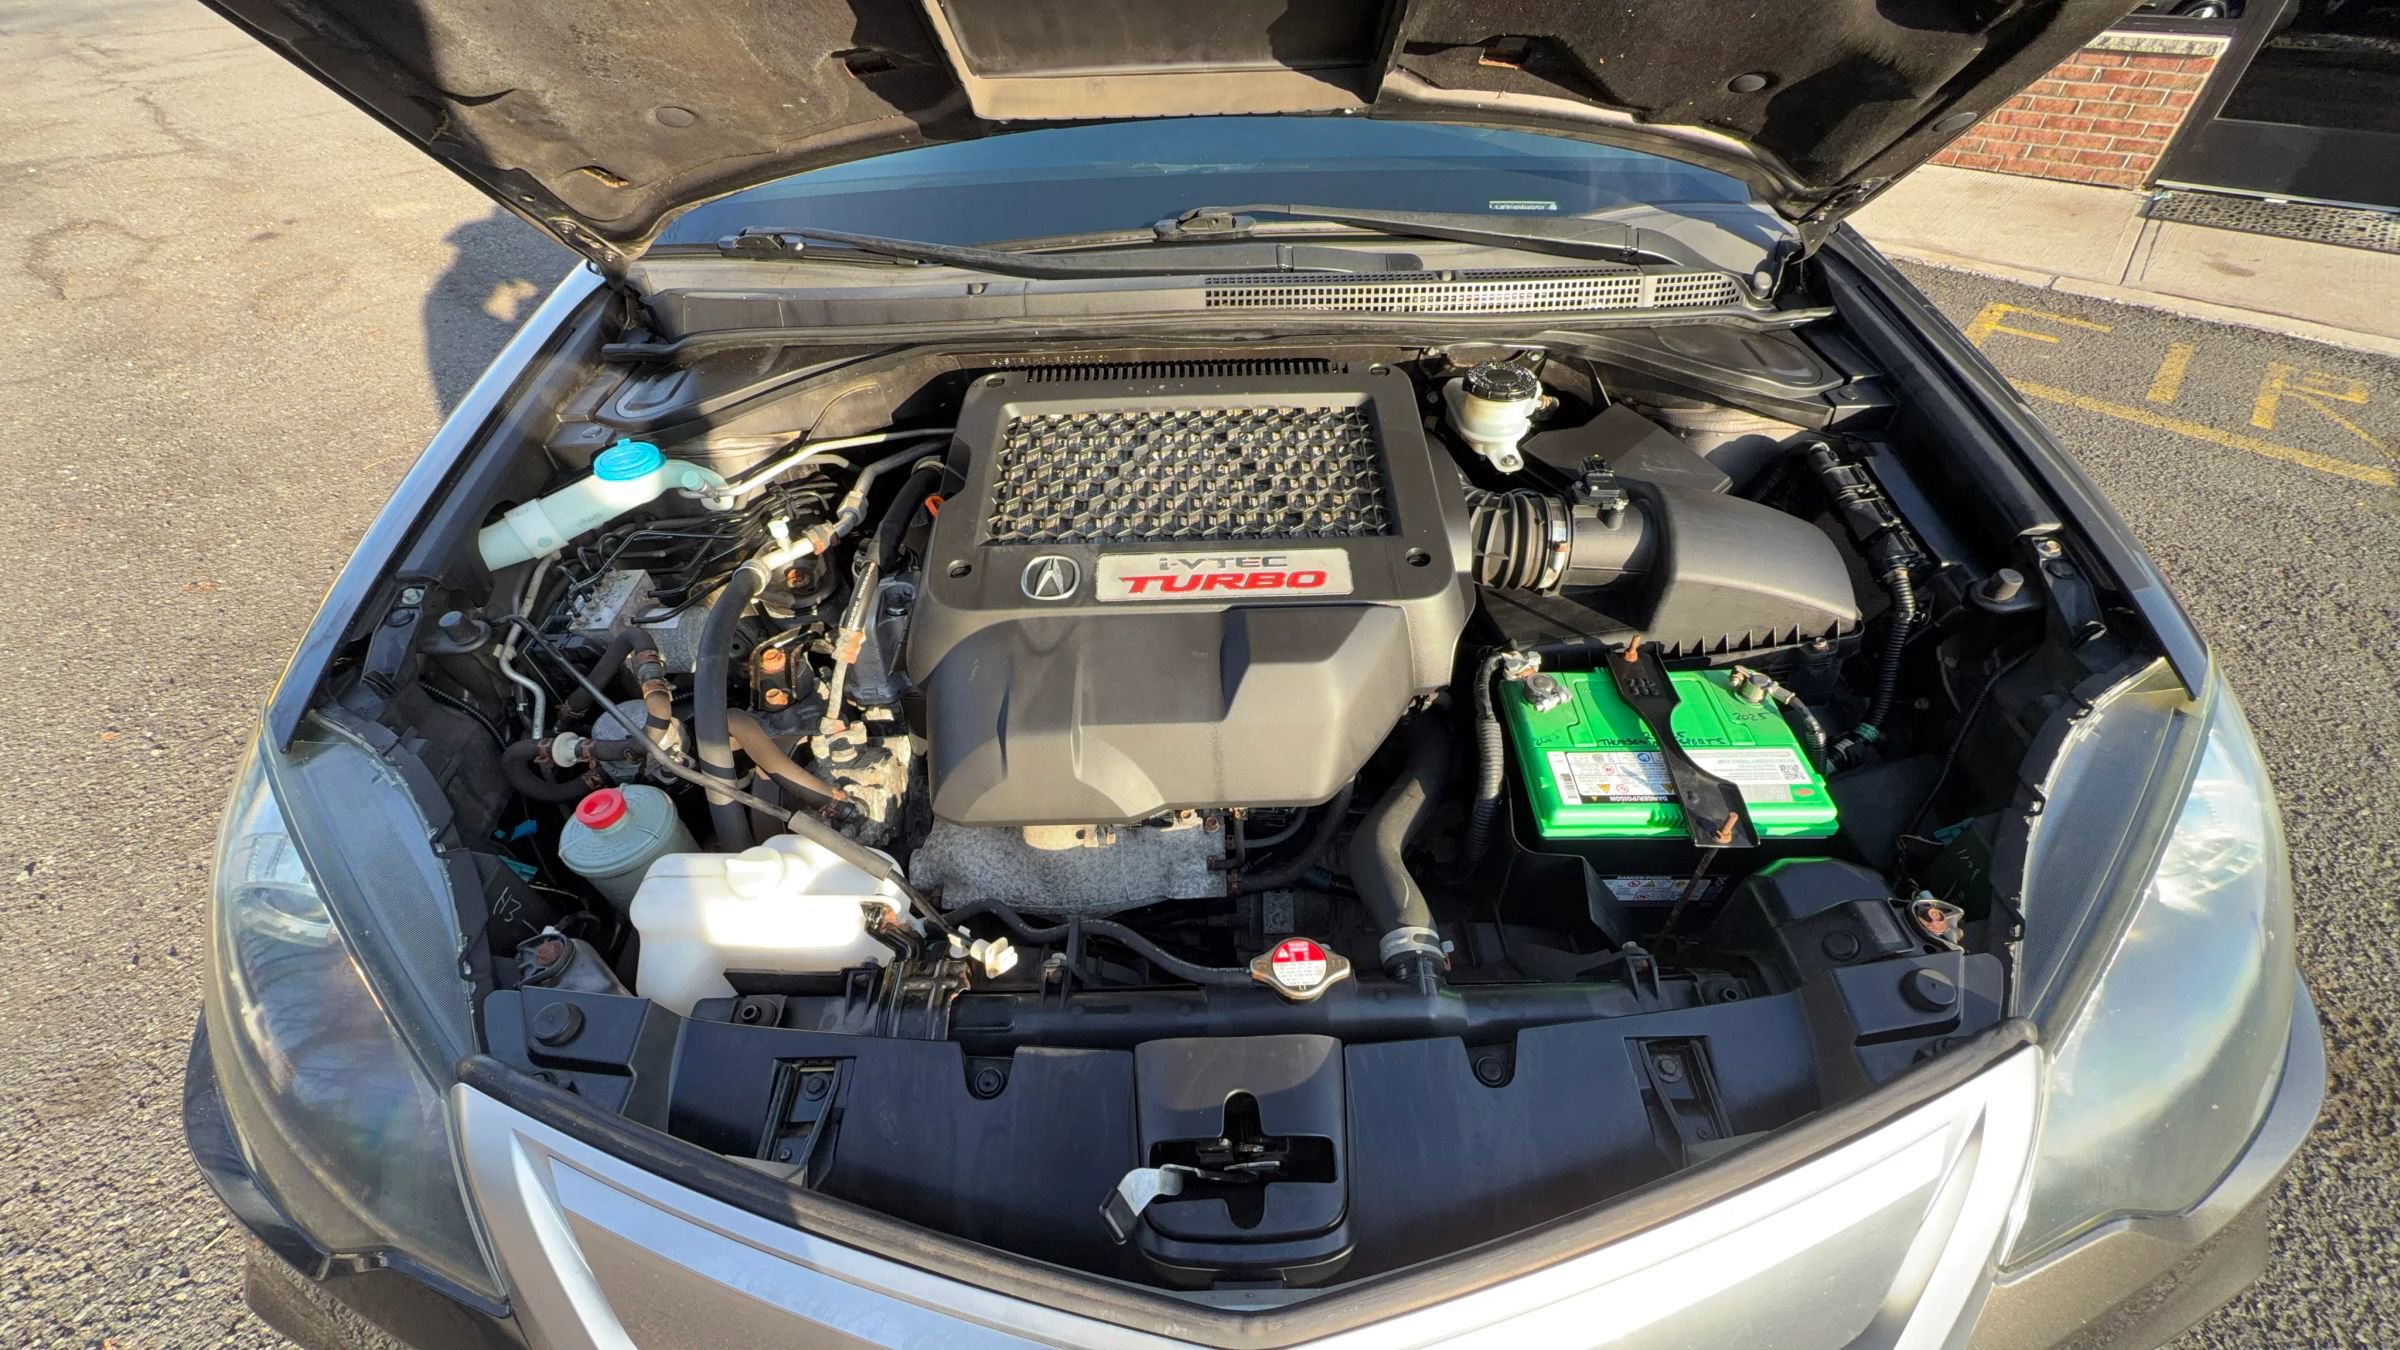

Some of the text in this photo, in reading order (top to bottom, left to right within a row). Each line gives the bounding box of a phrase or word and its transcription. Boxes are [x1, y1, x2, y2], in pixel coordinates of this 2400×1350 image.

[1159, 556, 1288, 571] i-VTEC
[1119, 570, 1329, 594] TURBO
[1732, 712, 1768, 721] 2025
